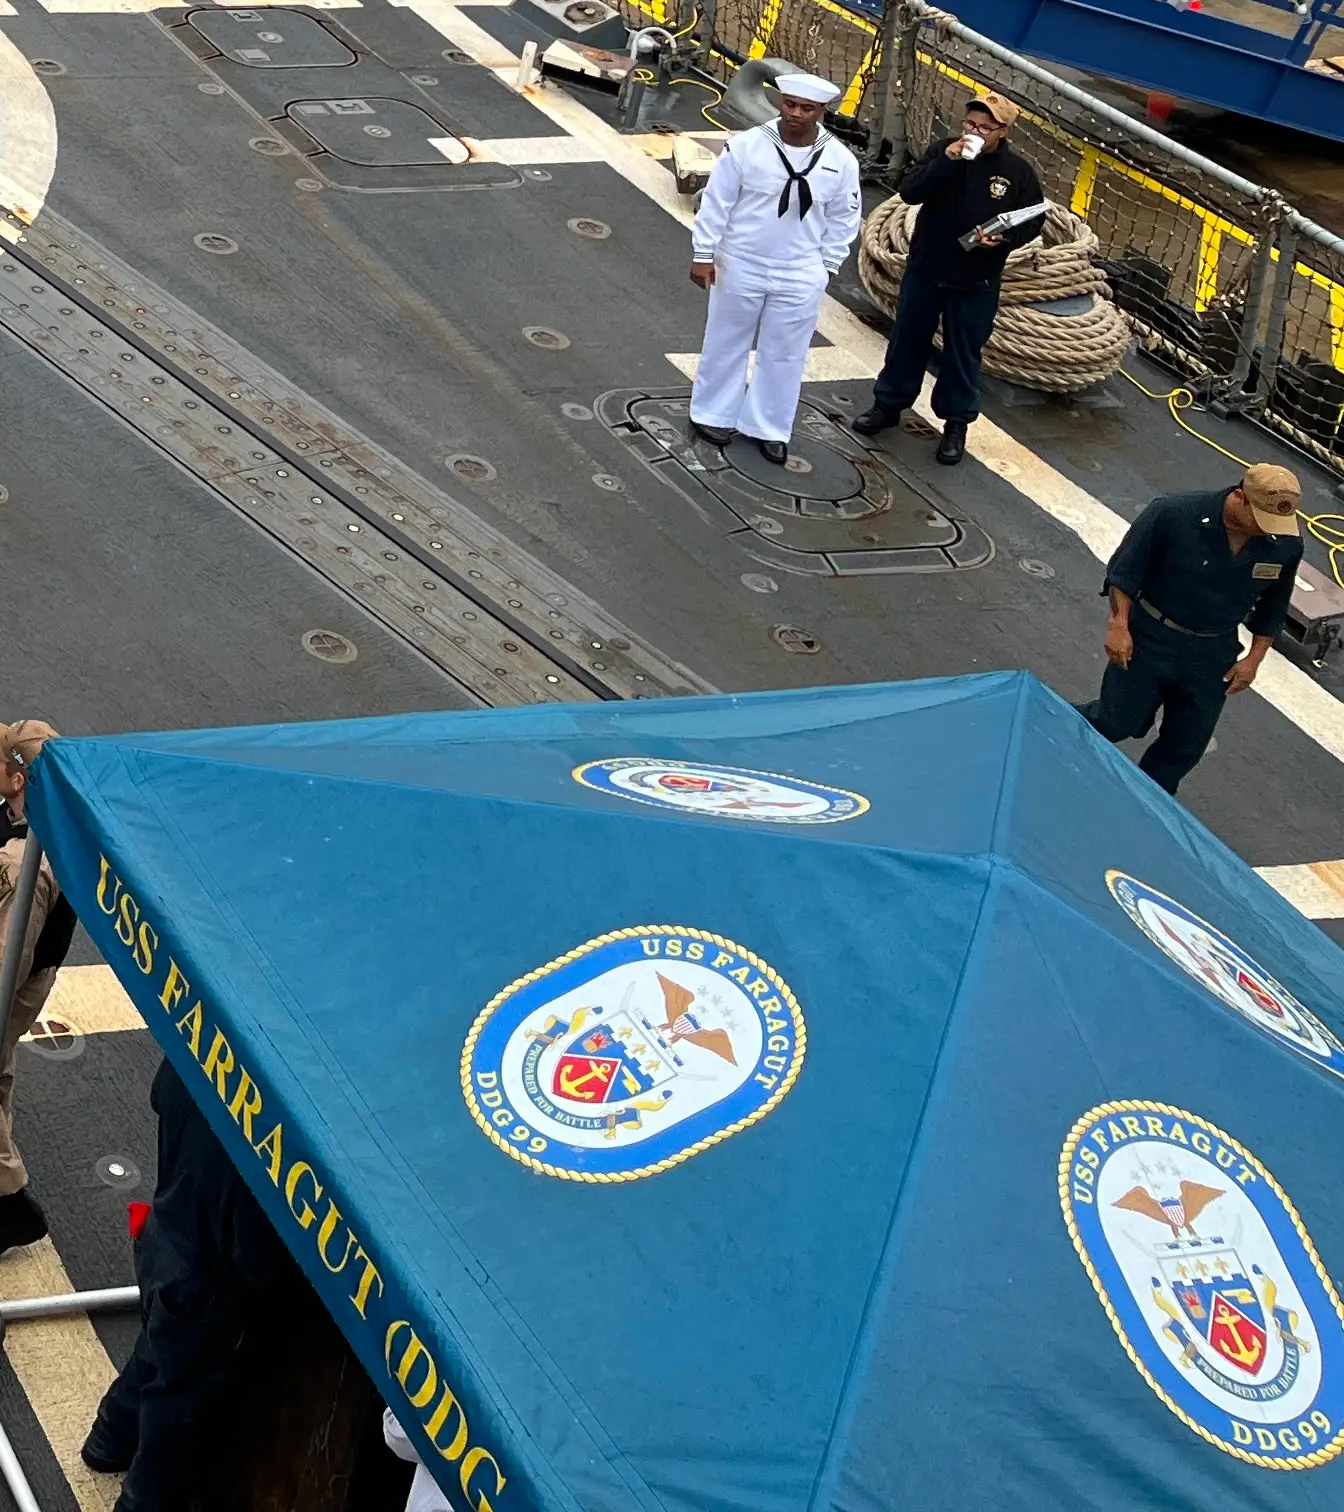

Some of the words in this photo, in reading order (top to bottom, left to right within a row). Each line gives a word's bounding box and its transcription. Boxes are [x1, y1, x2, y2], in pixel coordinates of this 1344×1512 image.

[640, 938, 705, 960] USS
[710, 951, 790, 1090] FARRAGUT
[95, 854, 160, 975] USS
[159, 957, 387, 1323] FARRAGUT
[522, 1042, 543, 1097] PREPARED
[533, 1094, 554, 1117] FOR
[554, 1110, 602, 1129] BATTLE
[1073, 1146, 1101, 1205] USS
[1090, 1115, 1258, 1188] FARRAGUT
[1195, 1356, 1258, 1400] PREPARED
[1259, 1383, 1281, 1400] FOR
[1279, 1346, 1298, 1394] BATTLE
